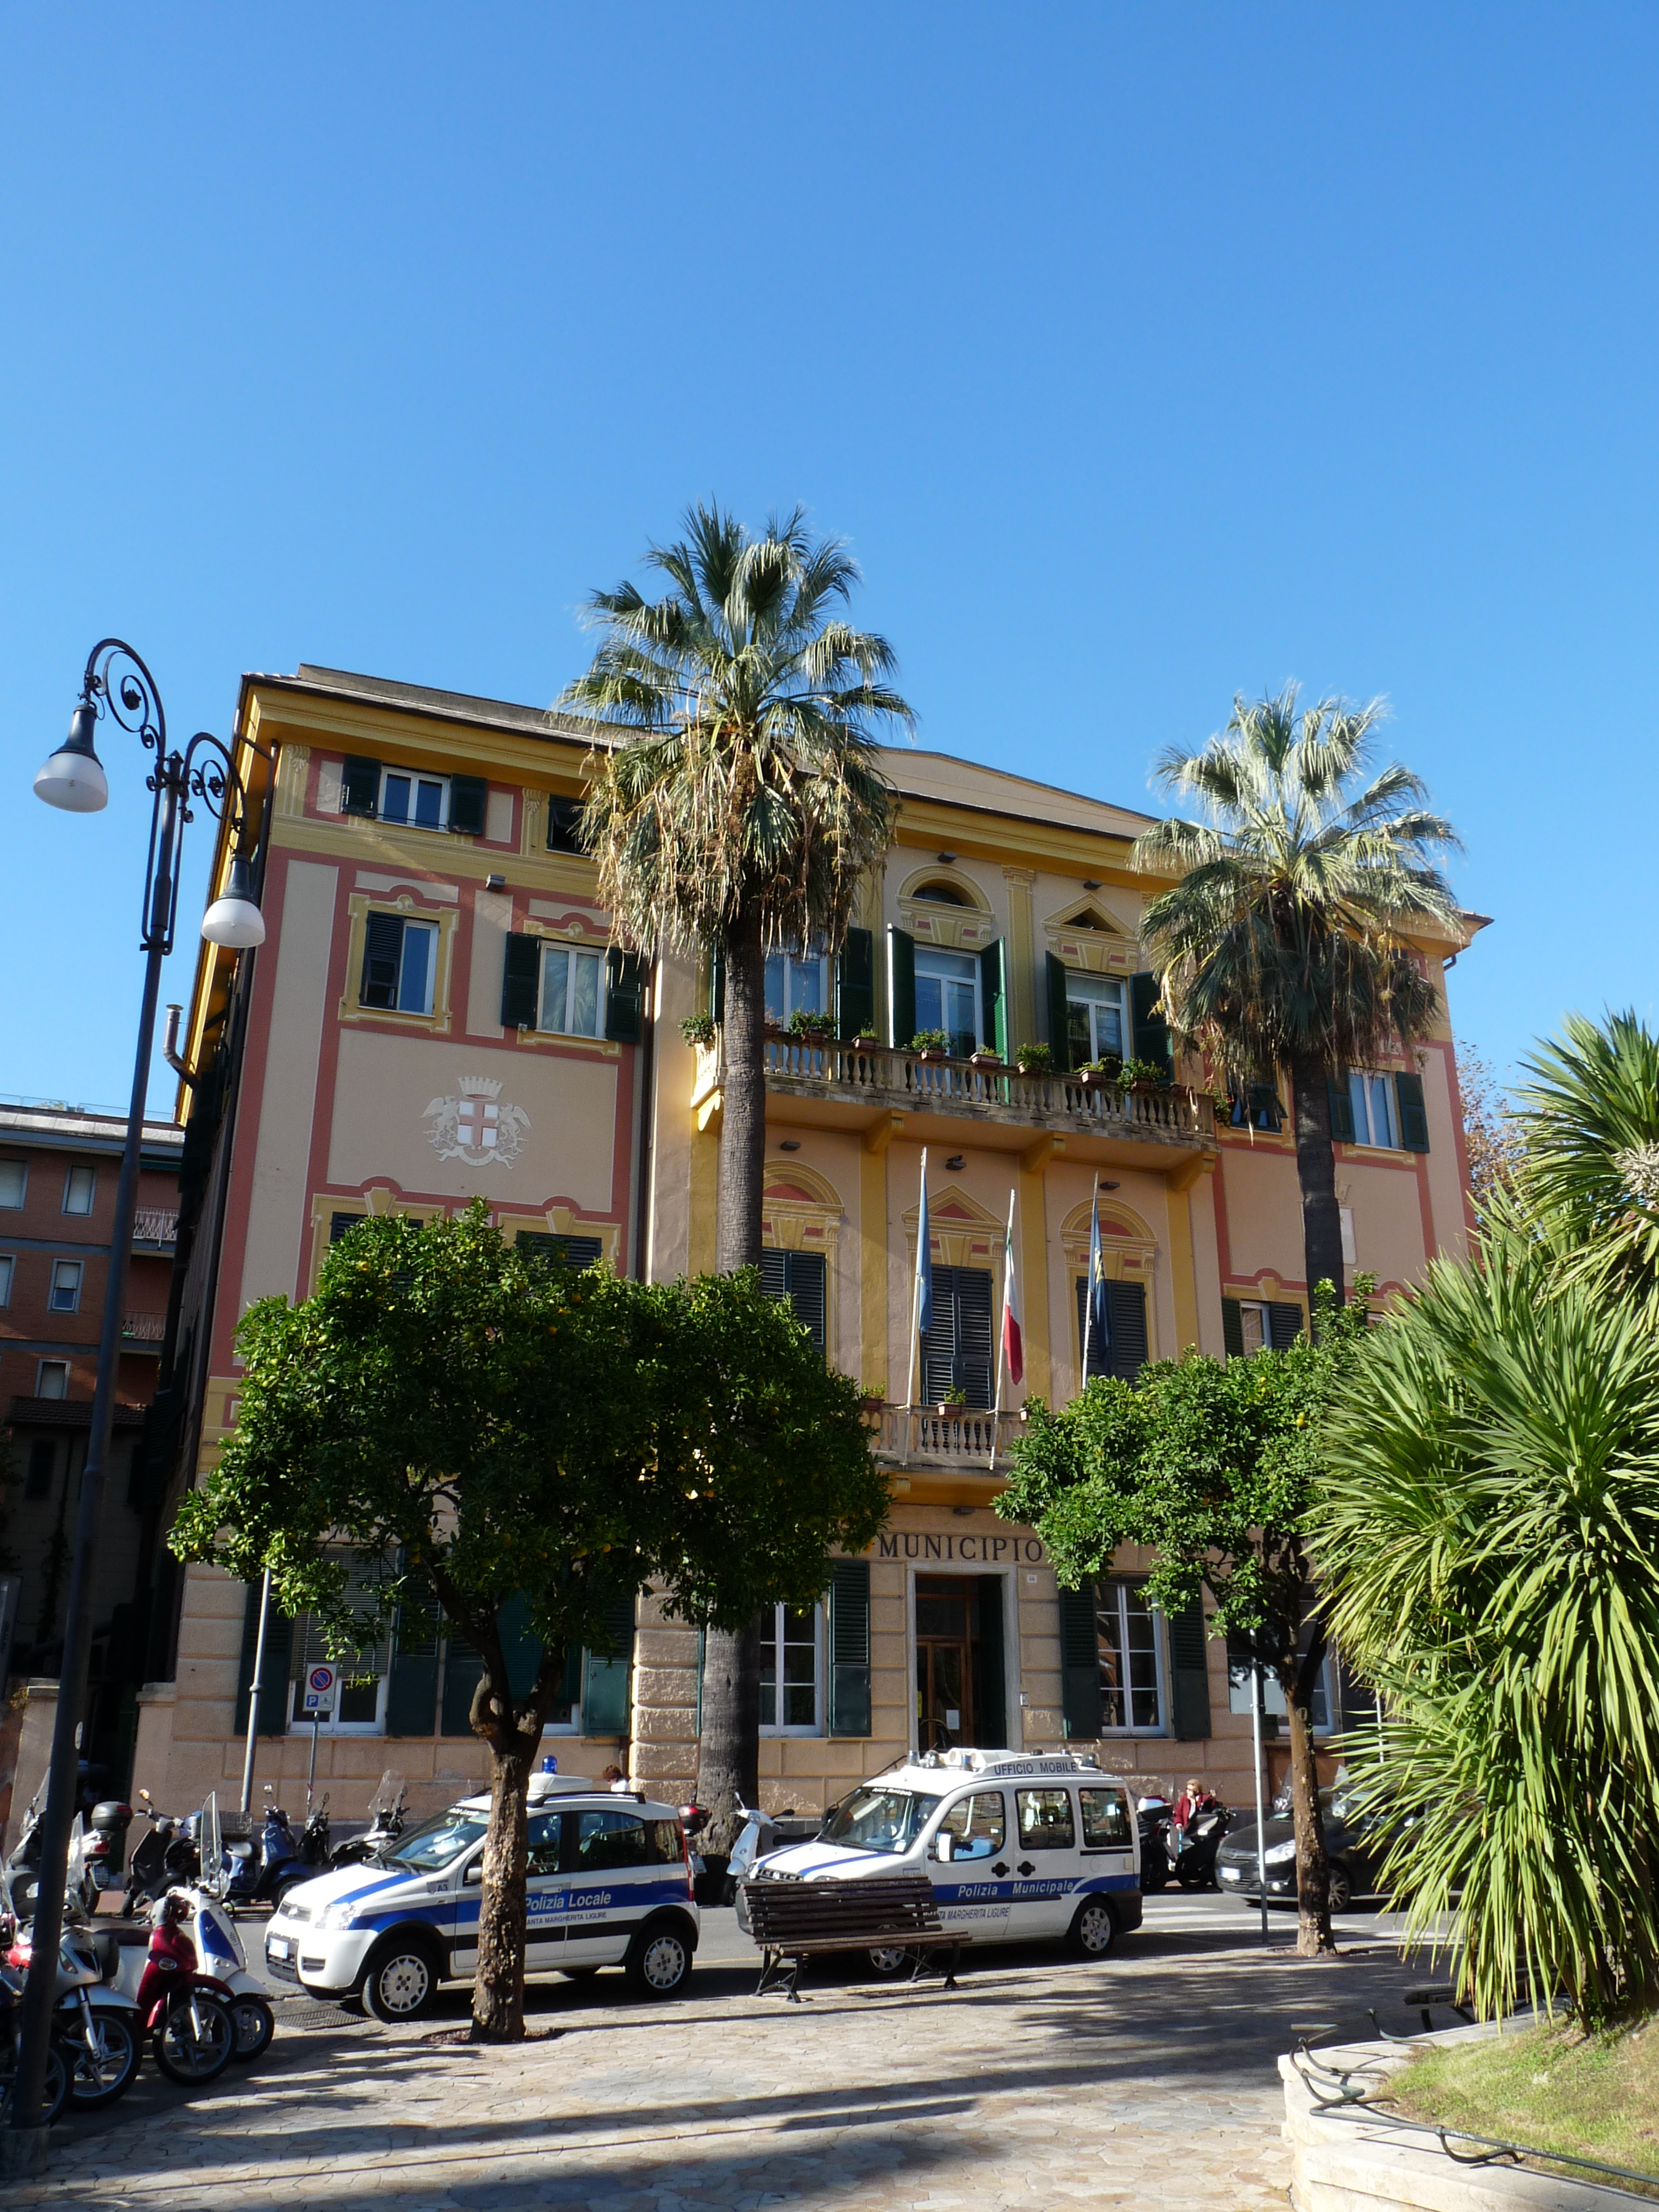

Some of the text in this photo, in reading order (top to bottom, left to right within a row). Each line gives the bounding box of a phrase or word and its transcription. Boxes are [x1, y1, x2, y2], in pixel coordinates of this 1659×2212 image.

[879, 1533, 1043, 1562] MUNICIPIO
[309, 1697, 316, 1705] P
[994, 1761, 1078, 1775] UFFICIO MOBILE
[957, 1880, 1073, 1897] Polizia Municipale
[525, 1891, 611, 1911] Polizia Locale
[527, 1917, 543, 1926] ANTA
[545, 1914, 583, 1923] MARGHERITA
[947, 1909, 986, 1920] MARGHERITA
[987, 1907, 1010, 1918] LIGURE
